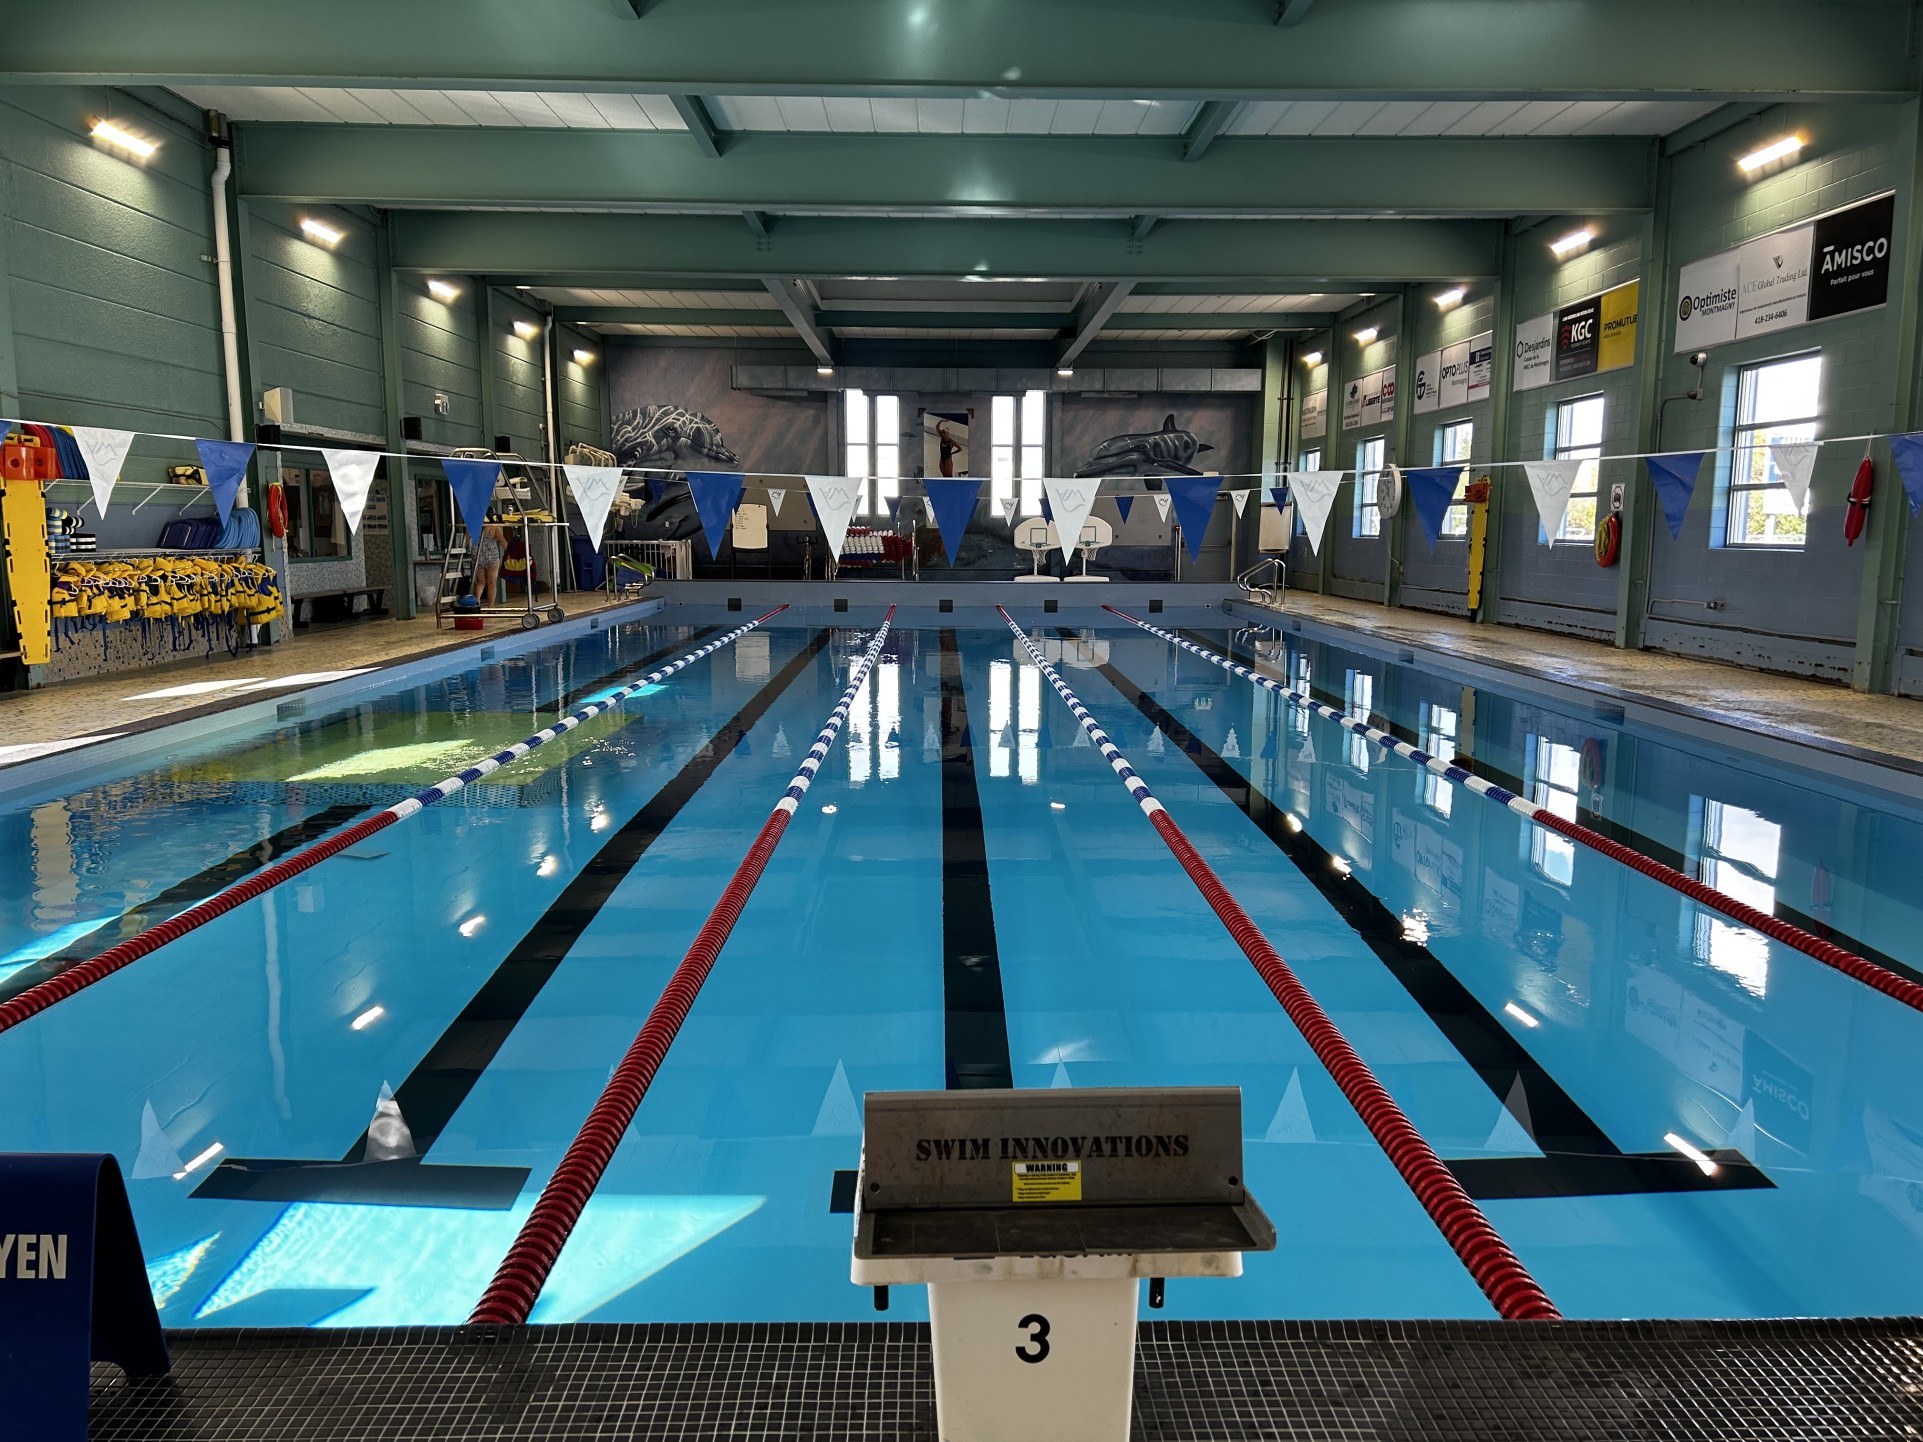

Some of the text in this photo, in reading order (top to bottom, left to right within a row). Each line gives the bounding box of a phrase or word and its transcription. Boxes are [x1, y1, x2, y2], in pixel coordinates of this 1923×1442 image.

[1741, 280, 1758, 295] ACE
[1757, 277, 1775, 290] Global
[1776, 272, 1797, 285] Trading
[1830, 269, 1874, 286] Parfait pour vous
[1693, 288, 1737, 312] Optimiste
[1701, 302, 1736, 317] MONTMAGNY
[1571, 318, 1594, 343] KGC
[1524, 336, 1551, 354] Desjardins
[915, 1134, 1190, 1161] SWIM INNOVATIONS
[1025, 1163, 1068, 1173] WARNING
[1014, 1313, 1051, 1364] 3
